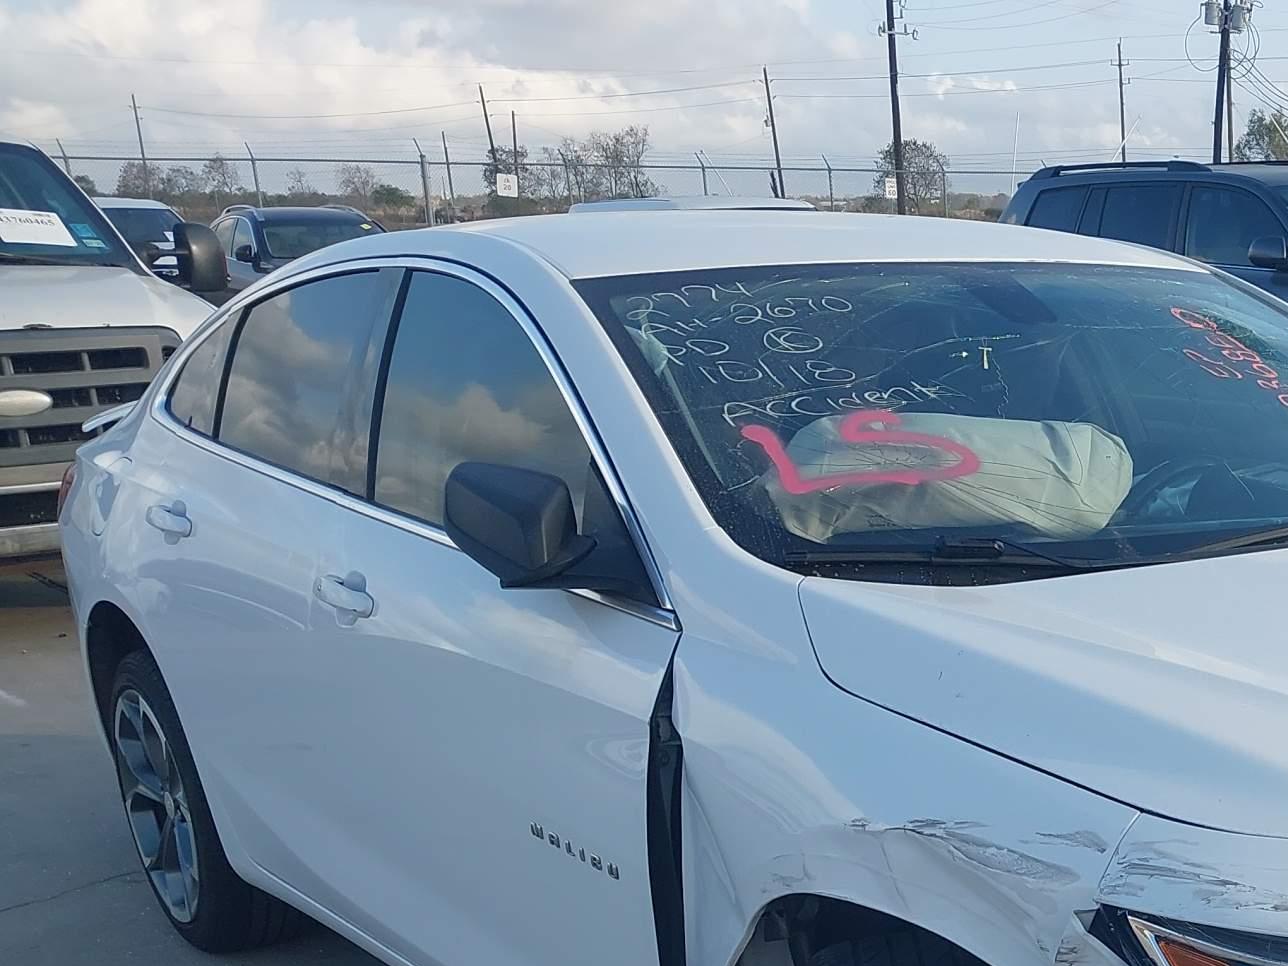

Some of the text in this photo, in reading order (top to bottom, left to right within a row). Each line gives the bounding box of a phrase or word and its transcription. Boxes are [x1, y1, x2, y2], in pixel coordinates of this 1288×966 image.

[626, 281, 753, 321] 2774
[698, 358, 856, 388] 10/18
[530, 821, 620, 880] MALIBU
